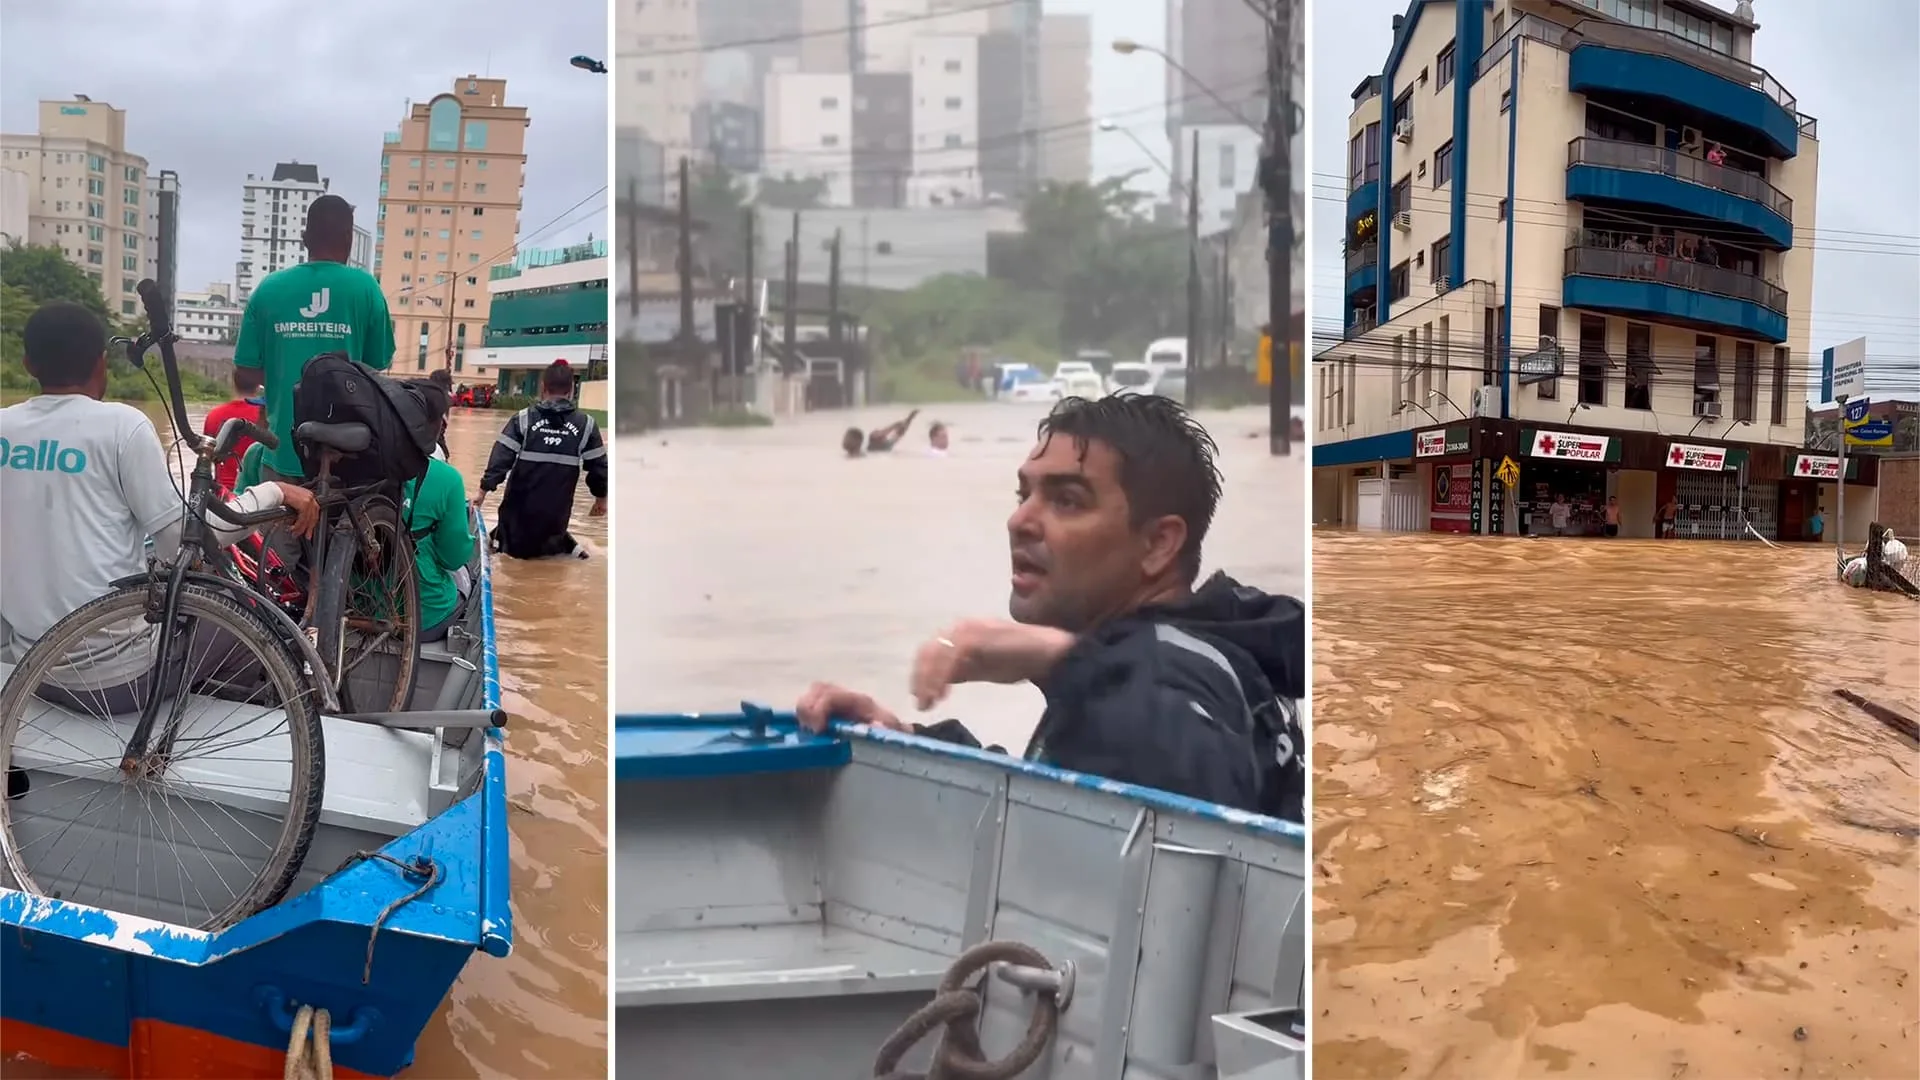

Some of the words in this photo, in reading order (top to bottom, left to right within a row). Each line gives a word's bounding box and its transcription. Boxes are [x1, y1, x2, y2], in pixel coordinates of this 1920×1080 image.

[274, 322, 352, 334] EMPREITEIRA
[1851, 407, 1863, 420] 127
[543, 436, 562, 446] 199
[1557, 439, 1581, 449] SUPER
[1565, 449, 1601, 459] POPULAR
[1685, 450, 1705, 460] SUPER
[1692, 459, 1722, 469] POPULAR
[1812, 461, 1828, 469] SUPER
[1819, 469, 1840, 477] POPULA
[1451, 493, 1472, 506] POPULA
